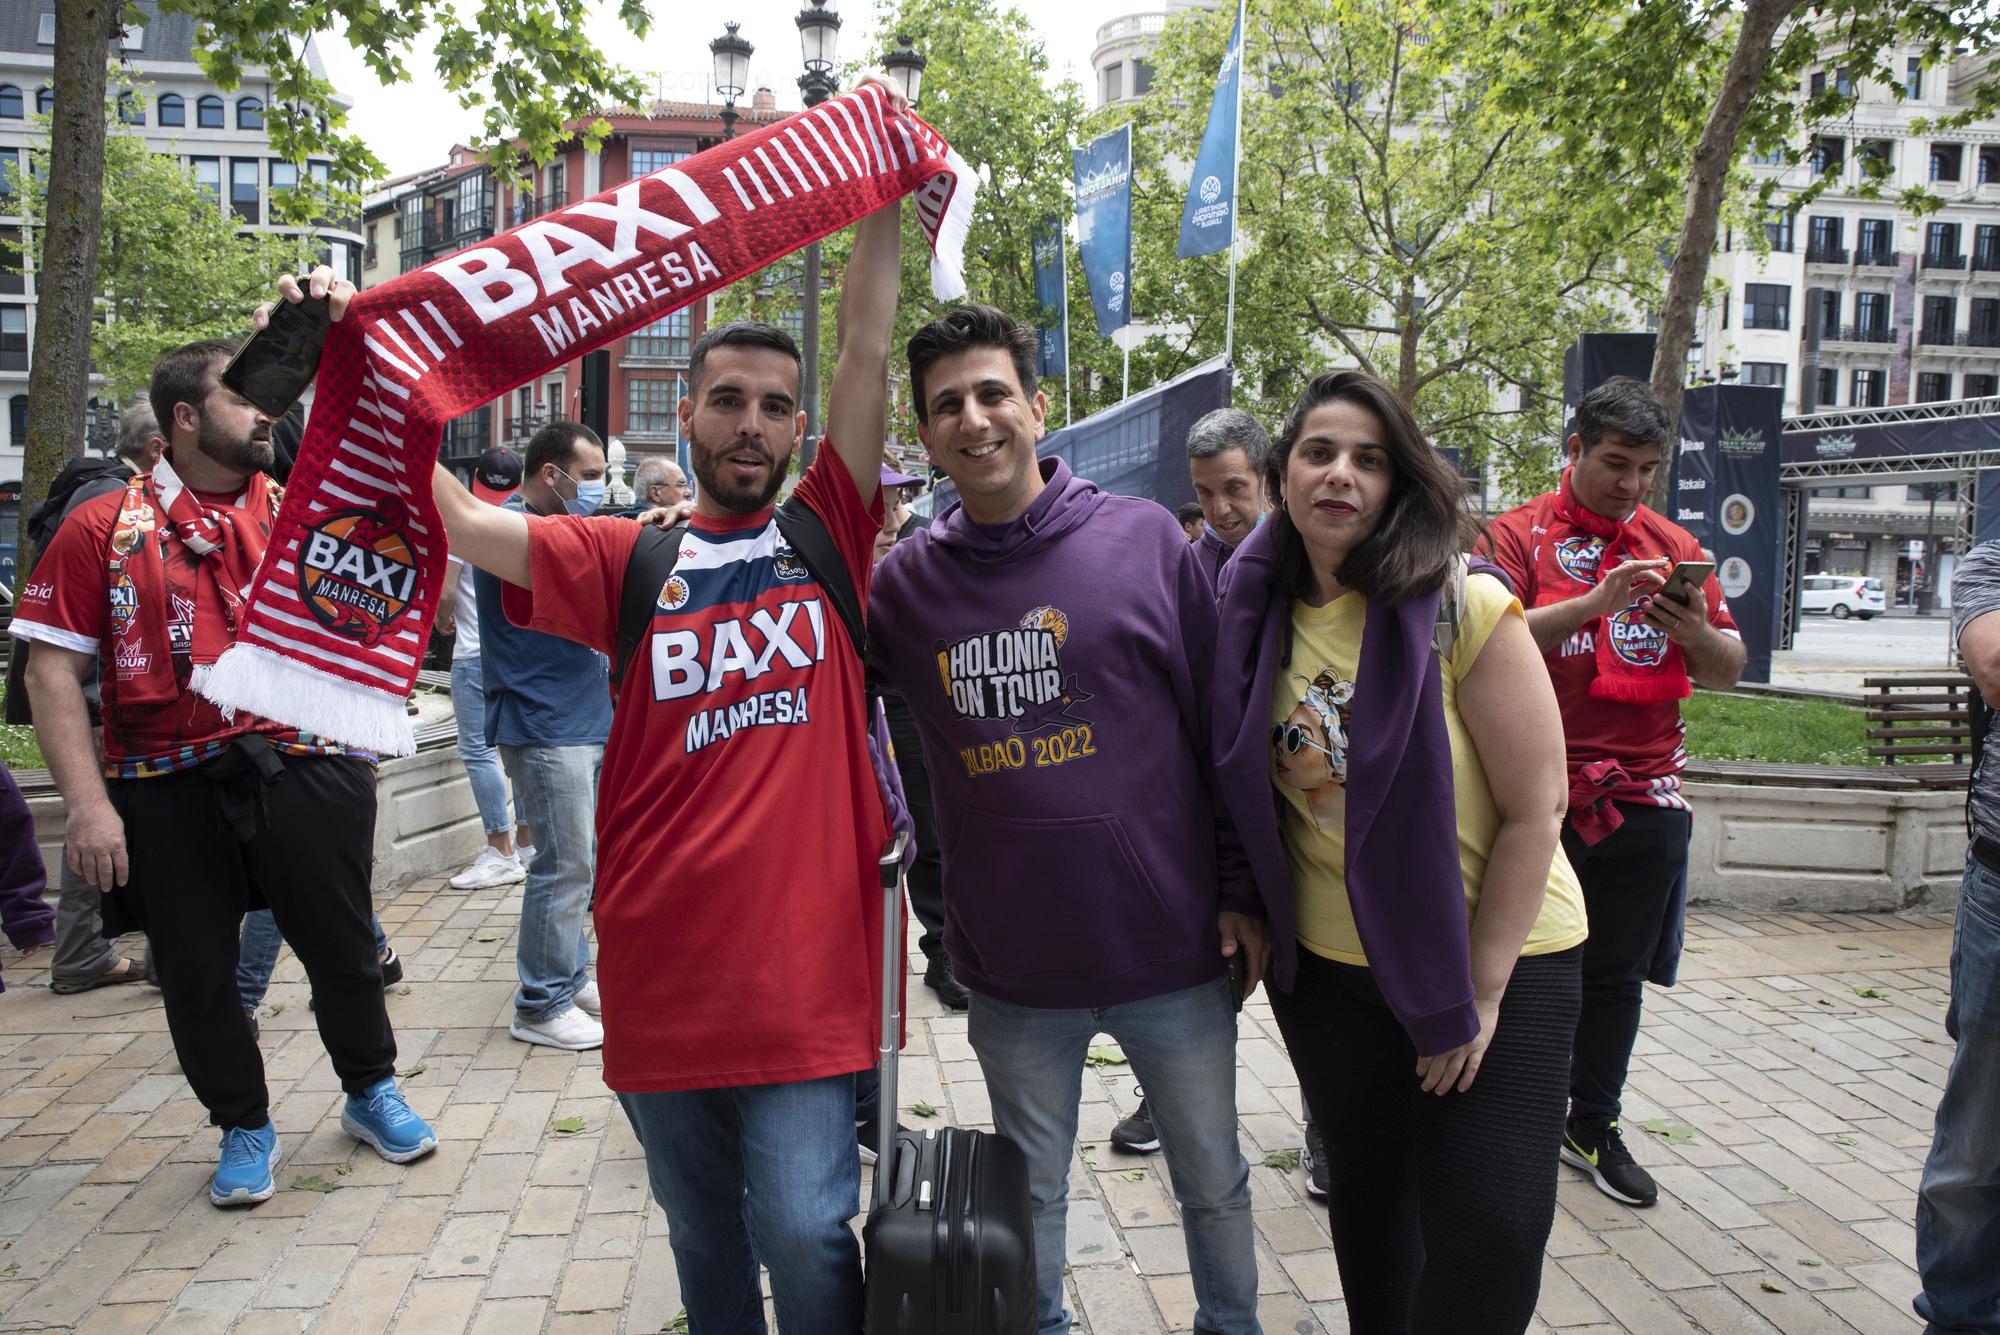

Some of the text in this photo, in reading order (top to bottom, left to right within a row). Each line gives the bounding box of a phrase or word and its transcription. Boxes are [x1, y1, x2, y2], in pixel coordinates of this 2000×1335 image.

[422, 168, 721, 325] BAXI
[529, 241, 721, 358] MANRESA
[305, 531, 417, 601] BAXI
[316, 578, 387, 619] MANRESA
[652, 598, 825, 701] BAXI
[951, 630, 1058, 679] HOLONIA
[1561, 631, 1598, 657] MA
[1622, 642, 1658, 650] MANRESA
[951, 669, 1061, 718] ON TOUR
[685, 688, 809, 755] MANRESA
[1032, 724, 1098, 768] 2022
